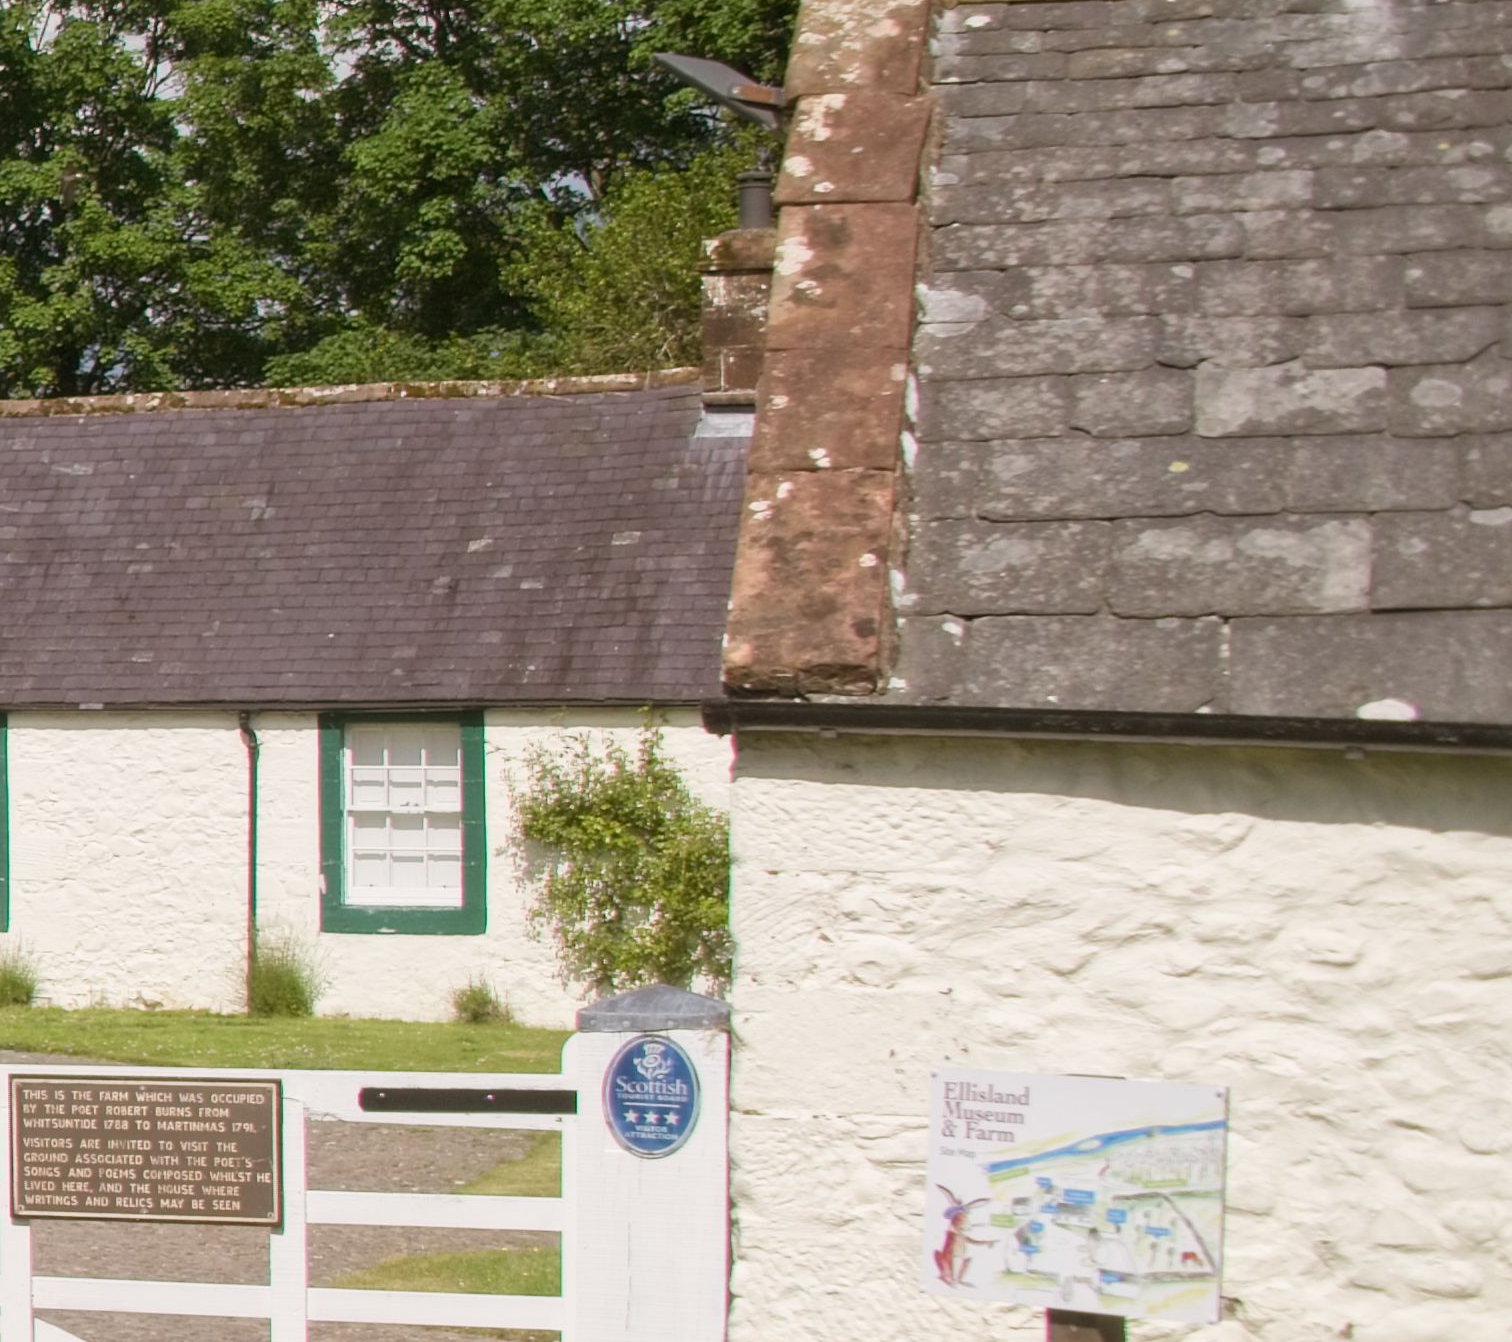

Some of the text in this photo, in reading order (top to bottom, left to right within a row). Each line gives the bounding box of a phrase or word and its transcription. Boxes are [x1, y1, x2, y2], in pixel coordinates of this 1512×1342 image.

[616, 1075, 688, 1095] Scottish
[22, 1089, 265, 1104] THIS IS THE FARM WHICH WAS OCCUPIED
[944, 1081, 1030, 1106] Ellisland
[23, 1104, 229, 1118] BY THE POET ROBERT BURNS FROM
[942, 1100, 1025, 1125] Museum
[23, 1118, 98, 1129] WHITSUNTIDE
[104, 1120, 129, 1130] 1788
[135, 1120, 150, 1131] TO
[157, 1121, 226, 1132] MARTINMAS
[941, 1119, 1015, 1143] & Farm
[23, 1138, 238, 1153] VISITORS ARE INVITED TO VISIT THE
[24, 1152, 68, 1163] GROUND
[75, 1154, 143, 1165] ASSOCIATED
[149, 1155, 179, 1166] WITH
[186, 1156, 208, 1167] THE
[24, 1166, 272, 1183] SONGS AND POEMS COMPOSED WHILST HE
[24, 1181, 55, 1191] LIVED
[98, 1182, 122, 1193] AND
[129, 1183, 151, 1194] THE
[157, 1184, 195, 1195] HOUSE
[202, 1185, 240, 1196] WHERE
[25, 1195, 241, 1210] WRITINGS AND RELICS MAY BE SEEN
